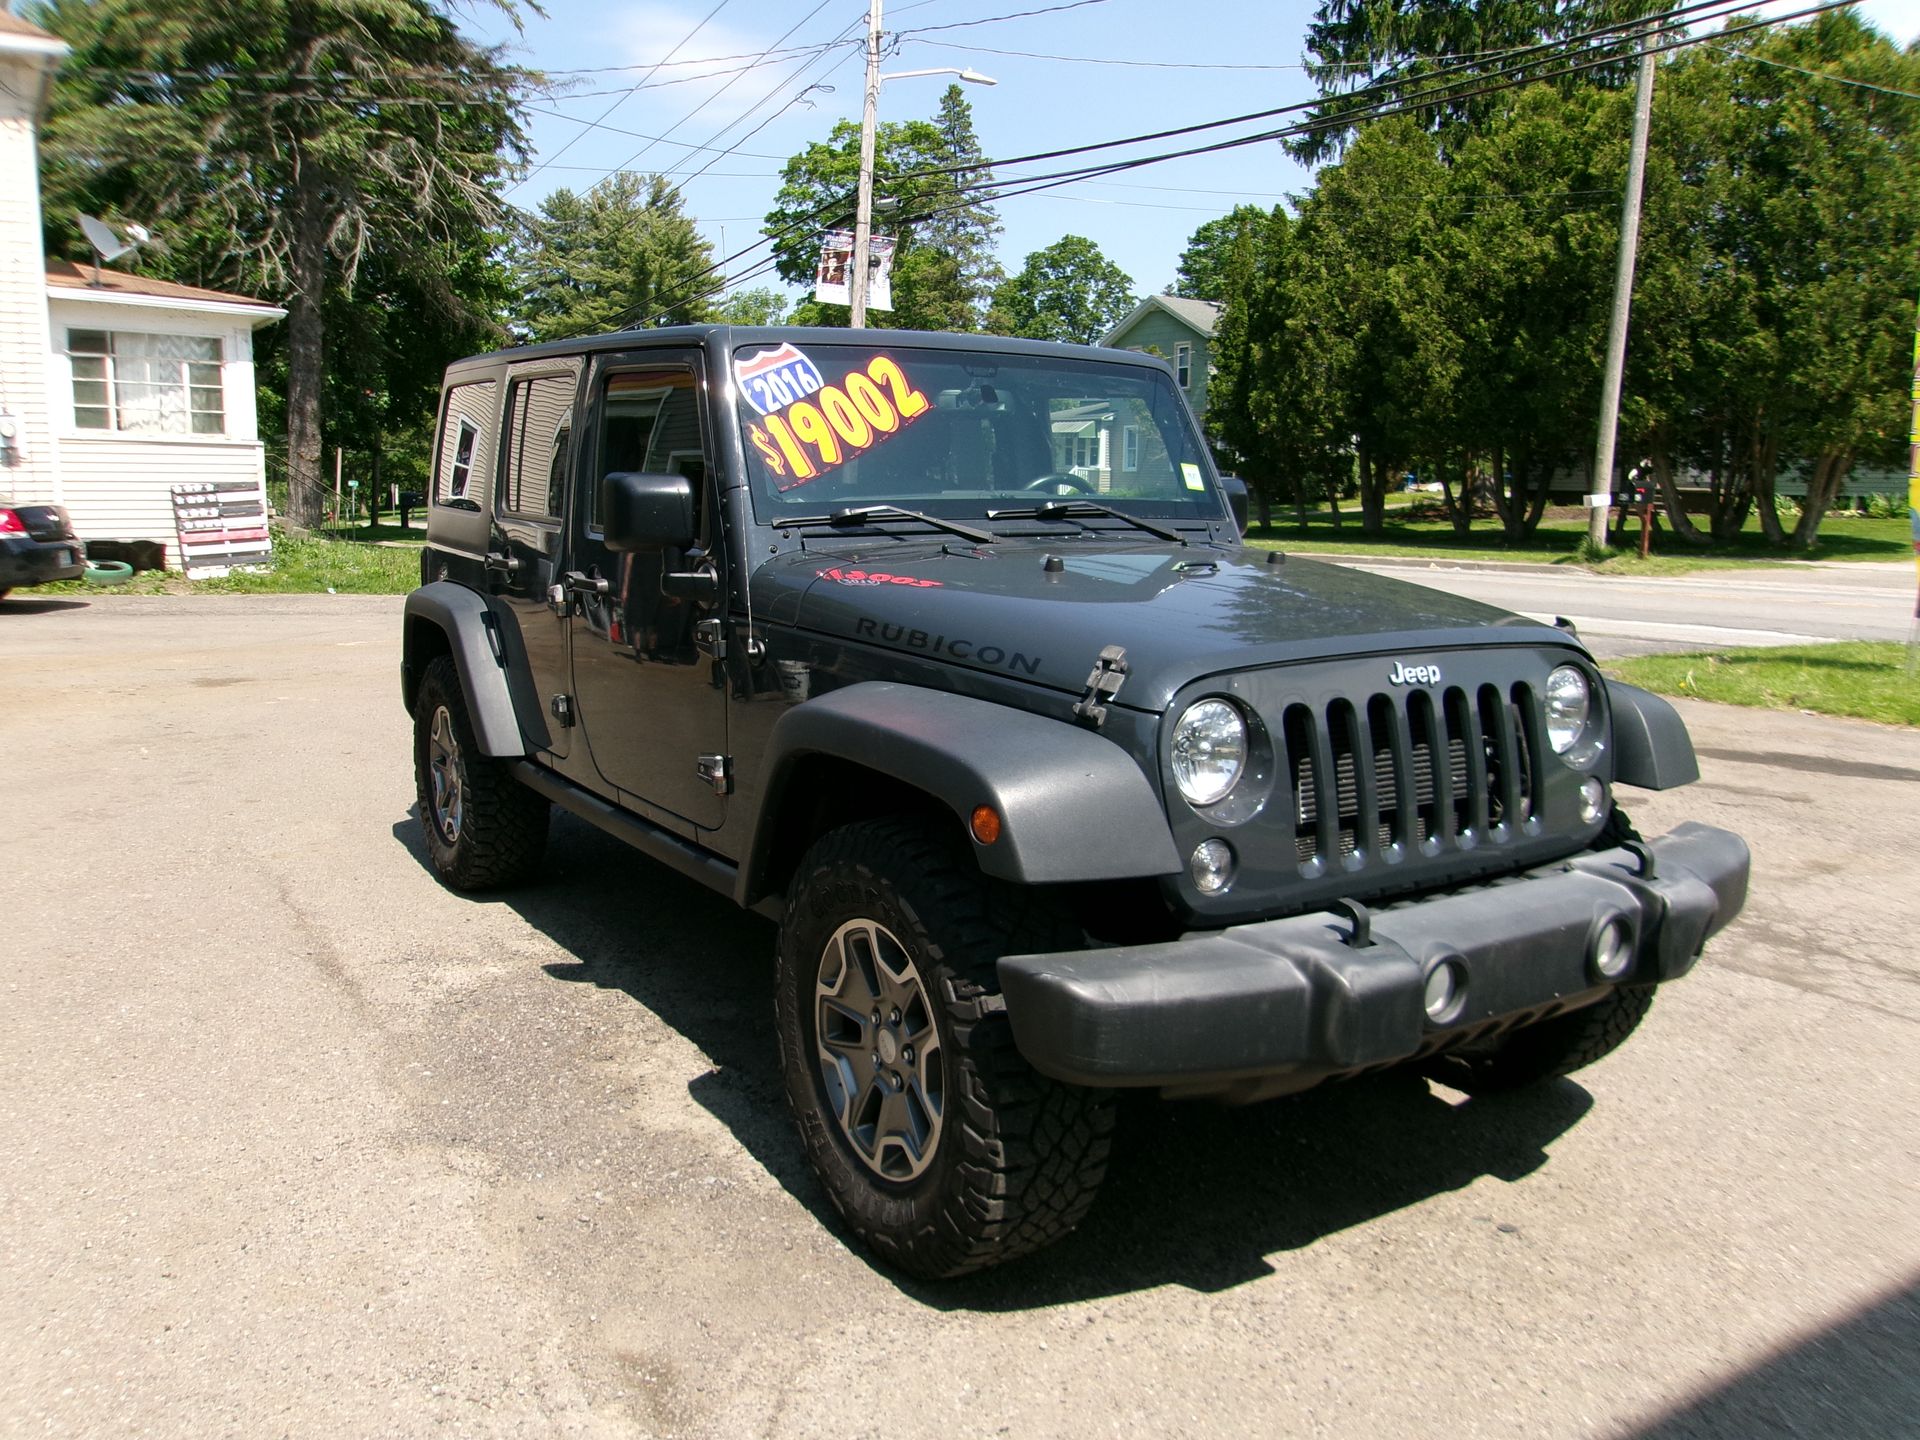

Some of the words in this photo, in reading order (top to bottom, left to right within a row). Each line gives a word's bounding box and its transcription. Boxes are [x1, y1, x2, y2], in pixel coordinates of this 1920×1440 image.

[753, 363, 820, 413] 2016
[750, 356, 930, 478] $19002
[855, 617, 1042, 674] RUBICON
[1388, 661, 1441, 687] Jeep
